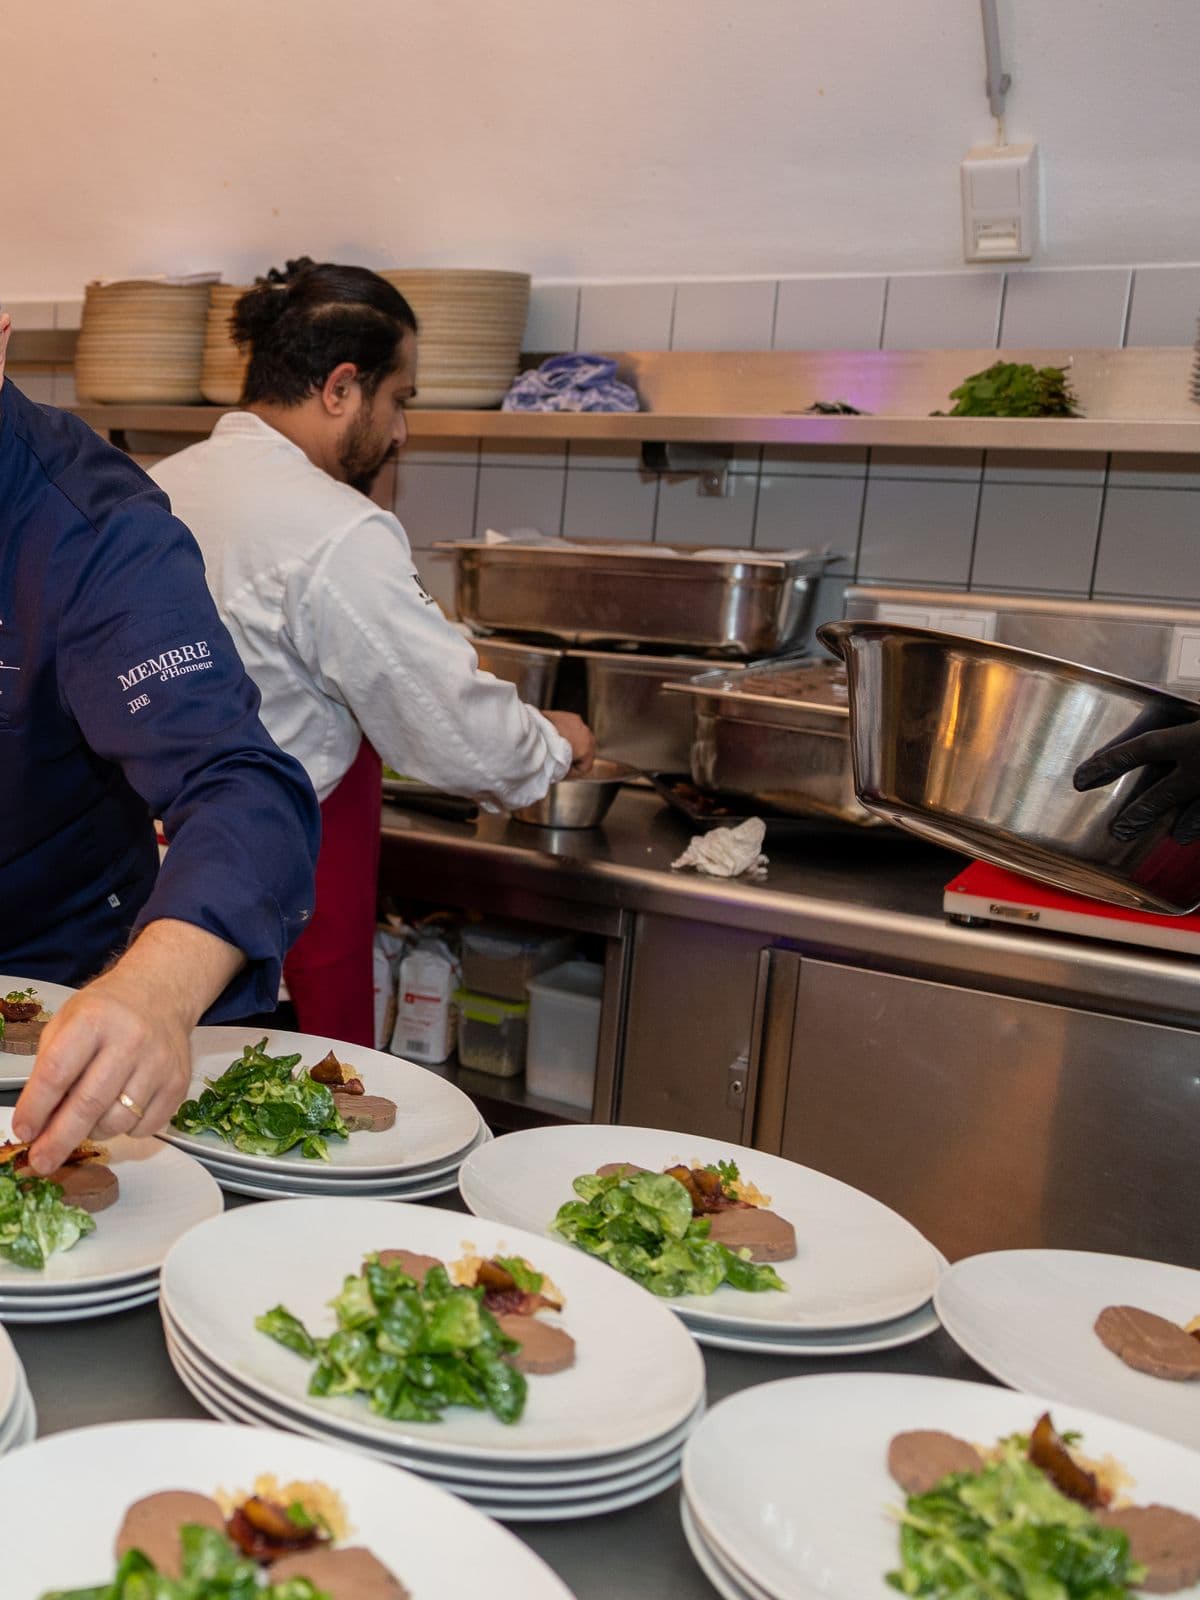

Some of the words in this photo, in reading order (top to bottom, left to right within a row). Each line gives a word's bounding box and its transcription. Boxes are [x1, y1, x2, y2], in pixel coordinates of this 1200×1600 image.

[117, 640, 211, 692] MEMBRE
[160, 660, 214, 682] d'Honneur
[127, 693, 151, 714] JRE
